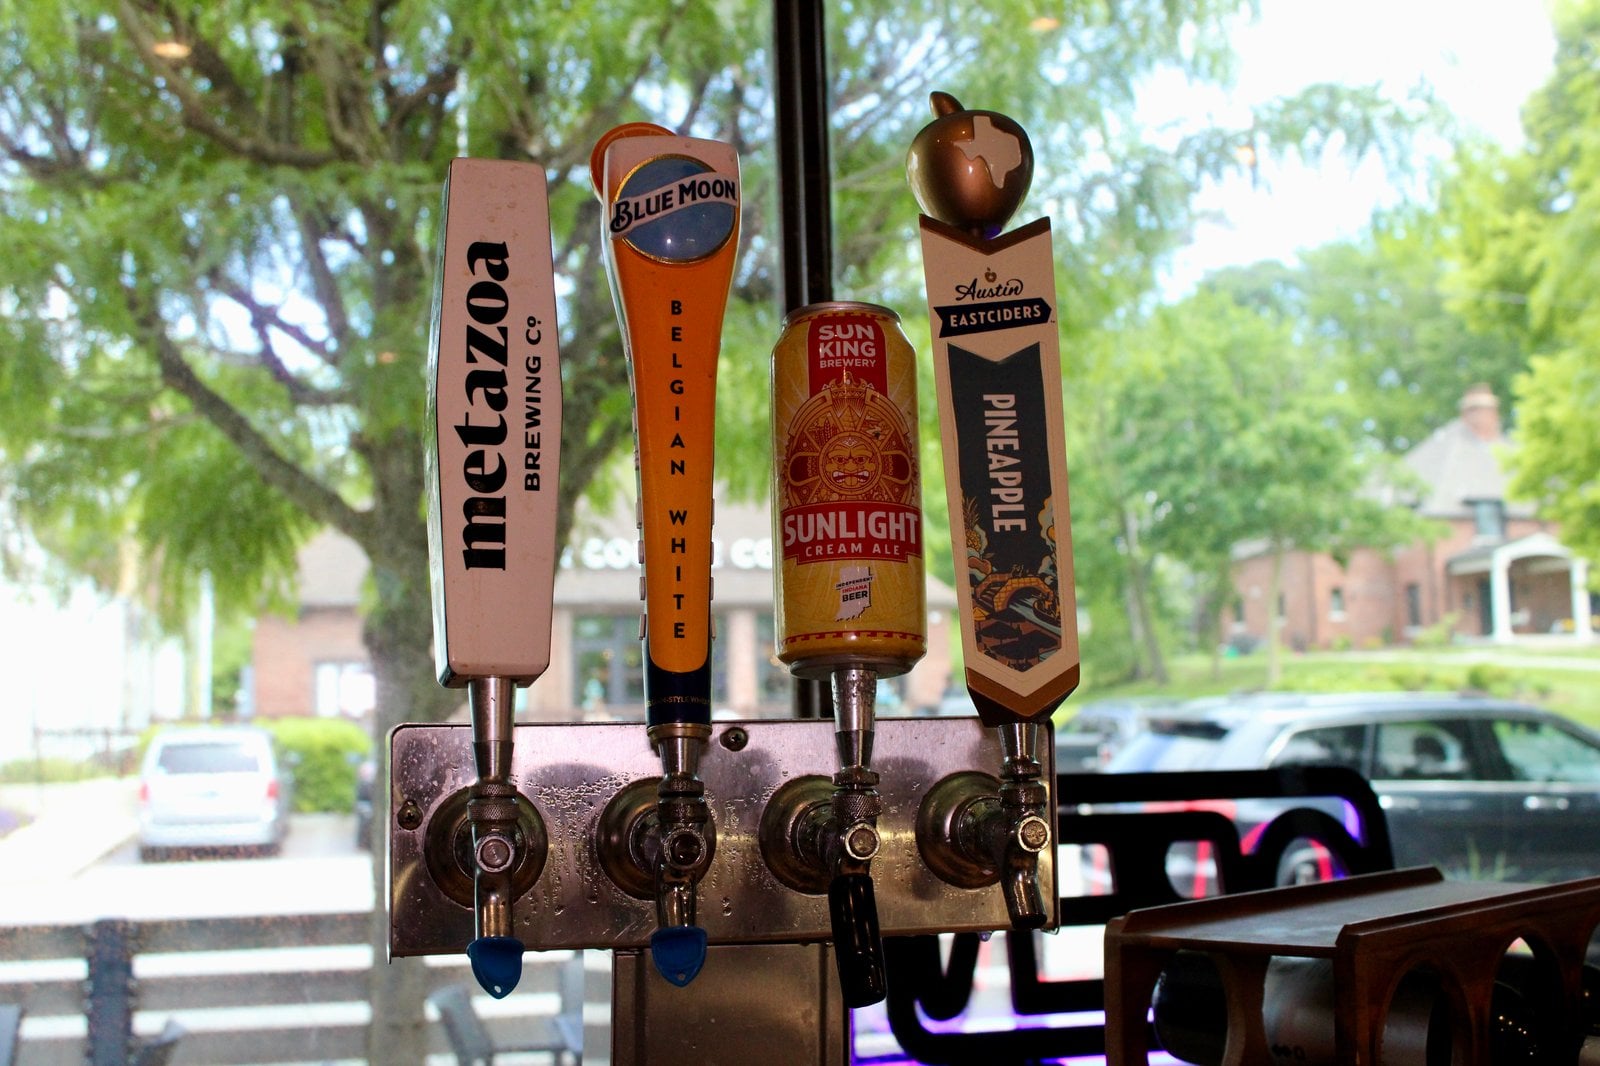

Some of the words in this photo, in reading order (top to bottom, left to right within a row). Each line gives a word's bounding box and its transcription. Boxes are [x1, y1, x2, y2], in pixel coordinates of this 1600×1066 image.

[610, 190, 673, 232] BLUE
[678, 179, 737, 205] MOON
[955, 278, 1024, 301] Austin
[950, 304, 1041, 327] EASTCIDERS
[818, 323, 875, 341] SUN
[819, 341, 876, 358] KING
[820, 358, 876, 369] BREWERY
[669, 300, 685, 475] BELGIAN
[453, 241, 509, 571] metazoa
[525, 355, 541, 491] BREWING
[983, 394, 1027, 533] PINEAPPLE
[784, 510, 918, 547] SUNLIGHT
[805, 542, 862, 557] CREAM
[872, 543, 900, 556] ALE
[669, 510, 688, 638] WHITE
[842, 584, 868, 594] INDIANA
[842, 590, 868, 602] BEER
